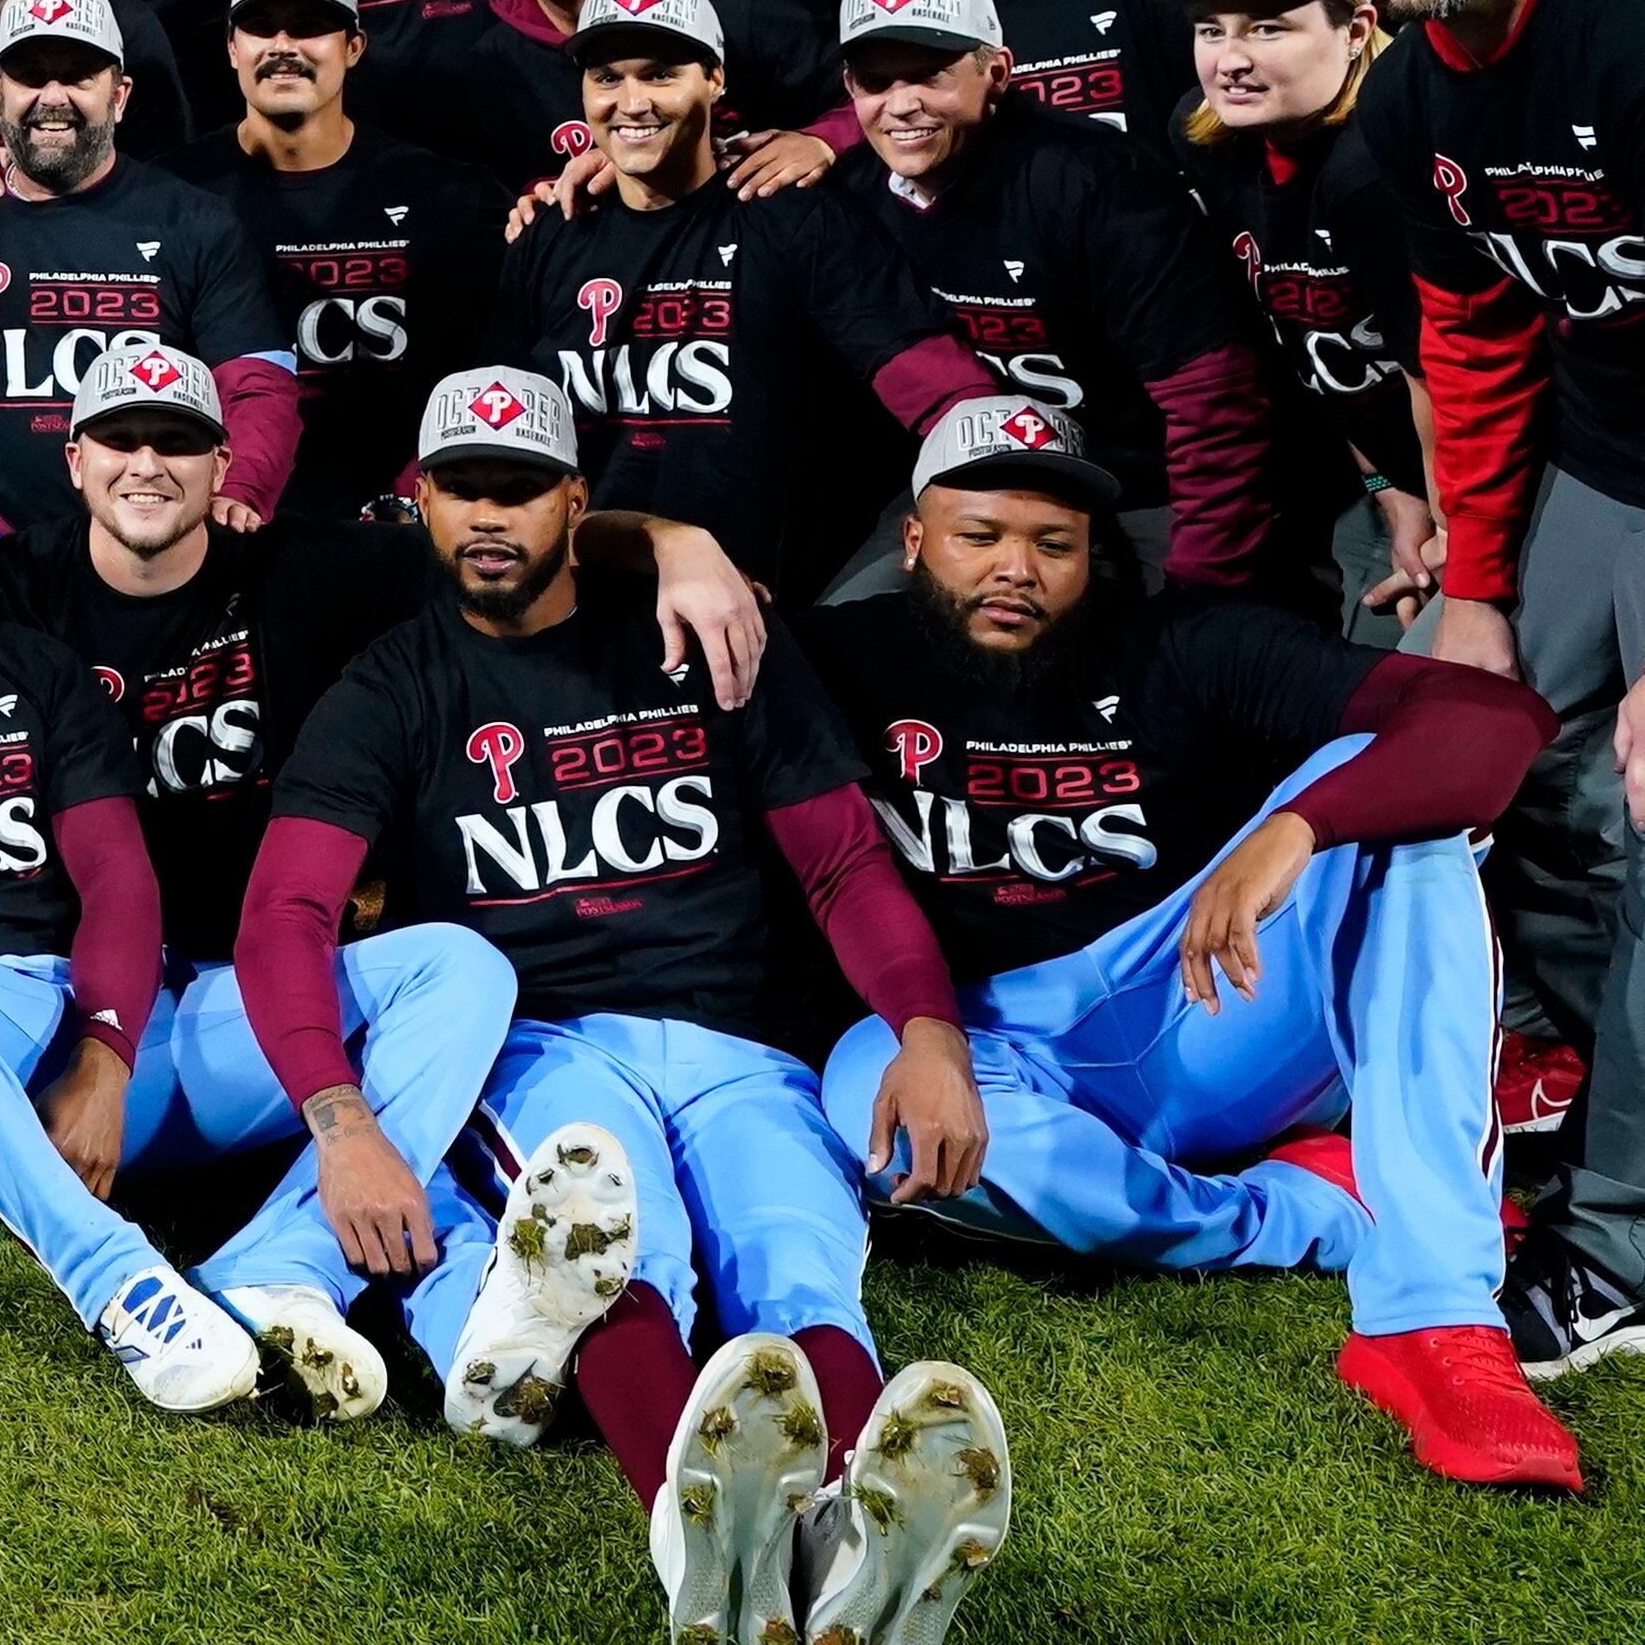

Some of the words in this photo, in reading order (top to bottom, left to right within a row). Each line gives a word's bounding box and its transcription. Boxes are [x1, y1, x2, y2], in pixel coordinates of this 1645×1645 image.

[1062, 49, 1122, 65] PHILLIES
[275, 241, 356, 253] PHILADELPHIA
[356, 239, 410, 250] PHILLIES
[28, 272, 107, 283] PHILADELPHIA
[107, 273, 161, 284] PHILLIES
[30, 288, 160, 319] 2023
[577, 277, 623, 346] P
[296, 295, 408, 365] CS
[543, 709, 638, 739] PHILADELPHIA
[638, 703, 700, 724] PHILLIES
[466, 721, 524, 804] P
[551, 729, 709, 785] 2023
[883, 719, 943, 781] P
[965, 738, 1067, 754] PHILADELPHIA
[1067, 737, 1133, 754] PHILLIES
[966, 760, 1142, 799] 2023
[454, 775, 719, 897] NLCS
[870, 789, 1158, 883] NLCS
